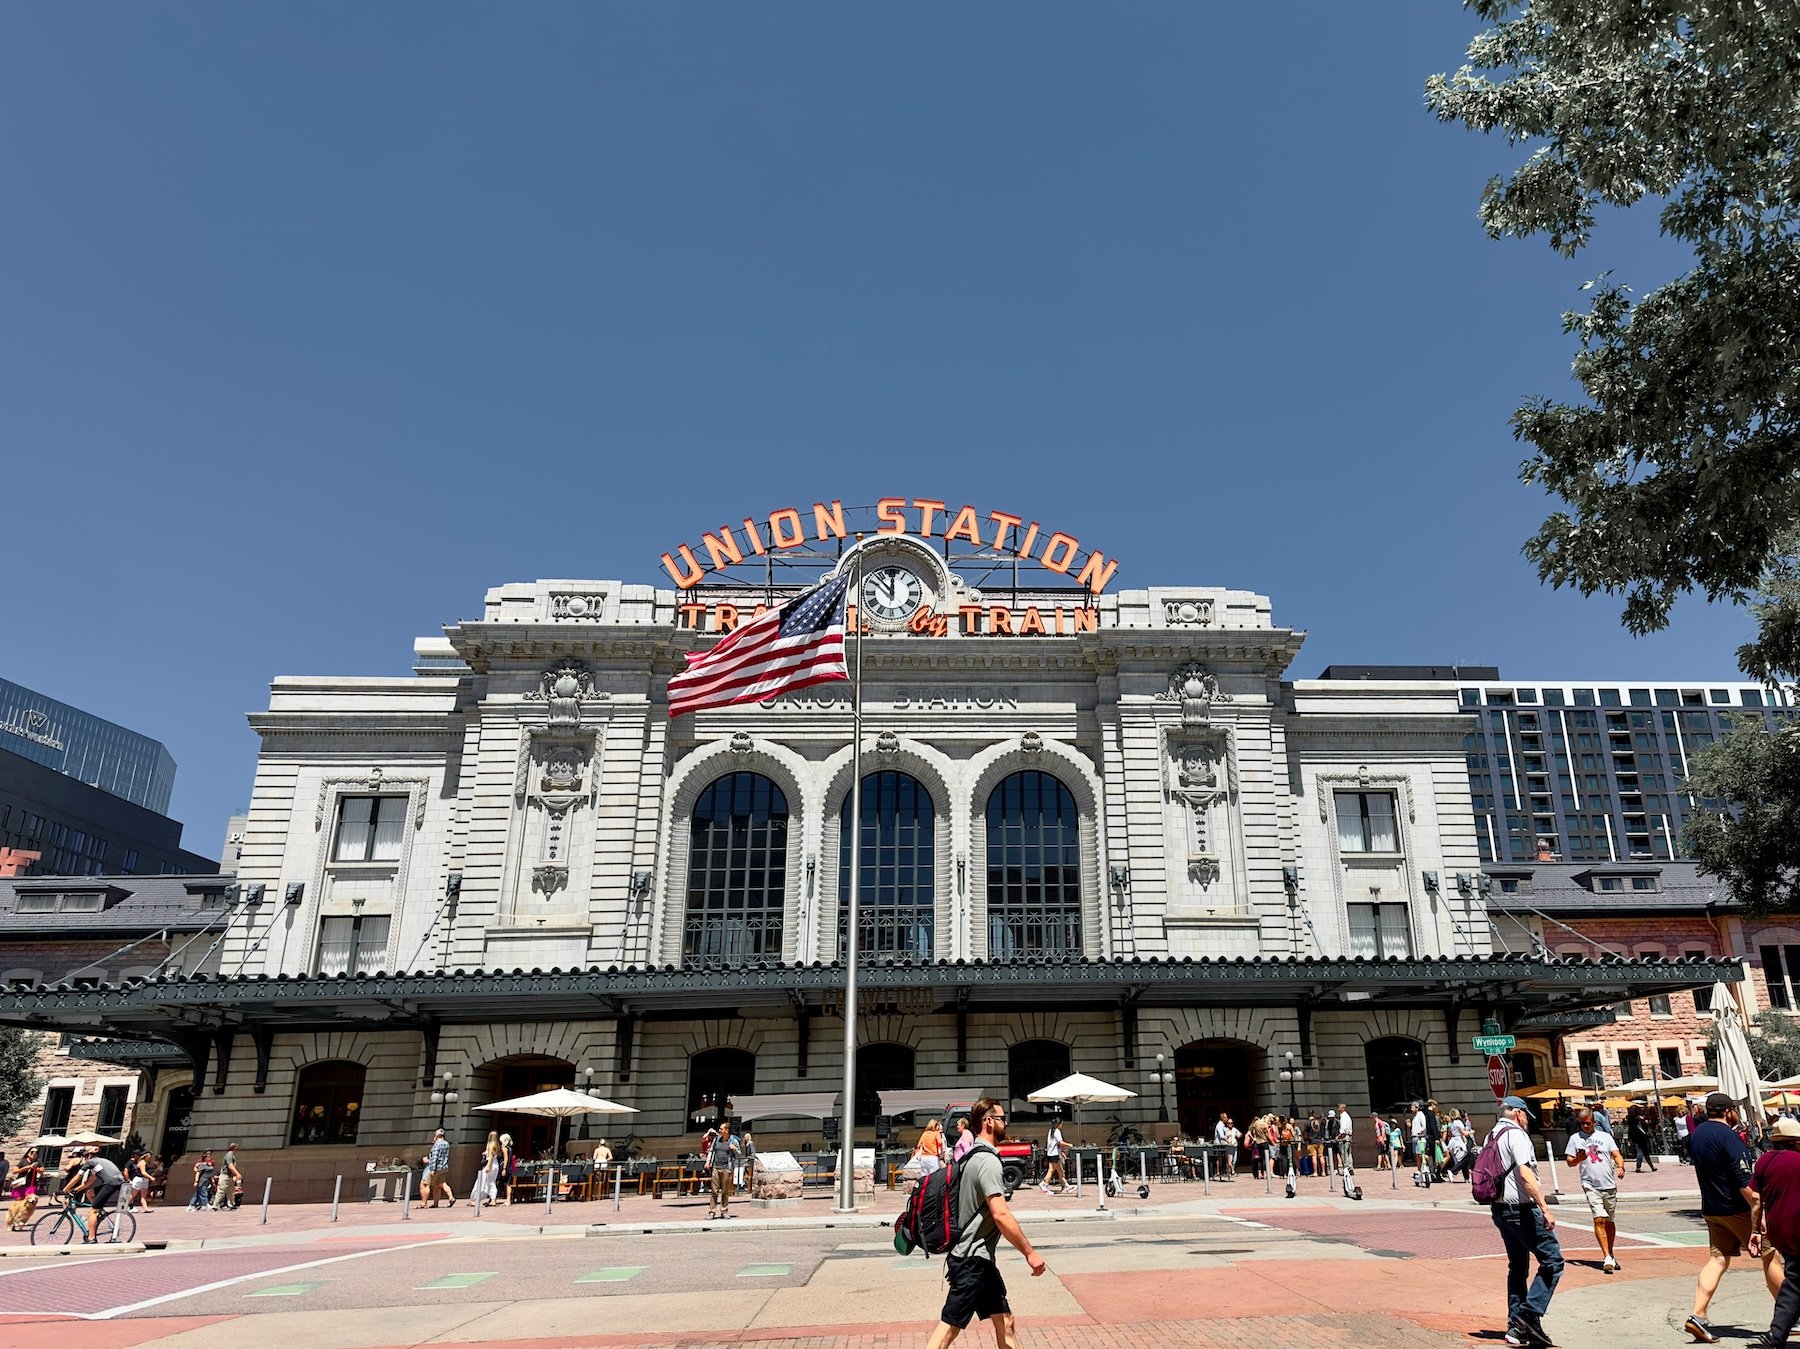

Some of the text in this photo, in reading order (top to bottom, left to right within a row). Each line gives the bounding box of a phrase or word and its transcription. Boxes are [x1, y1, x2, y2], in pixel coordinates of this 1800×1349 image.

[660, 500, 847, 589] UNION
[877, 497, 1119, 594] STATION
[908, 605, 947, 637] by
[959, 605, 1098, 635] TRAIN
[893, 687, 1018, 710] STATION
[1490, 1069, 1505, 1085] STOP
